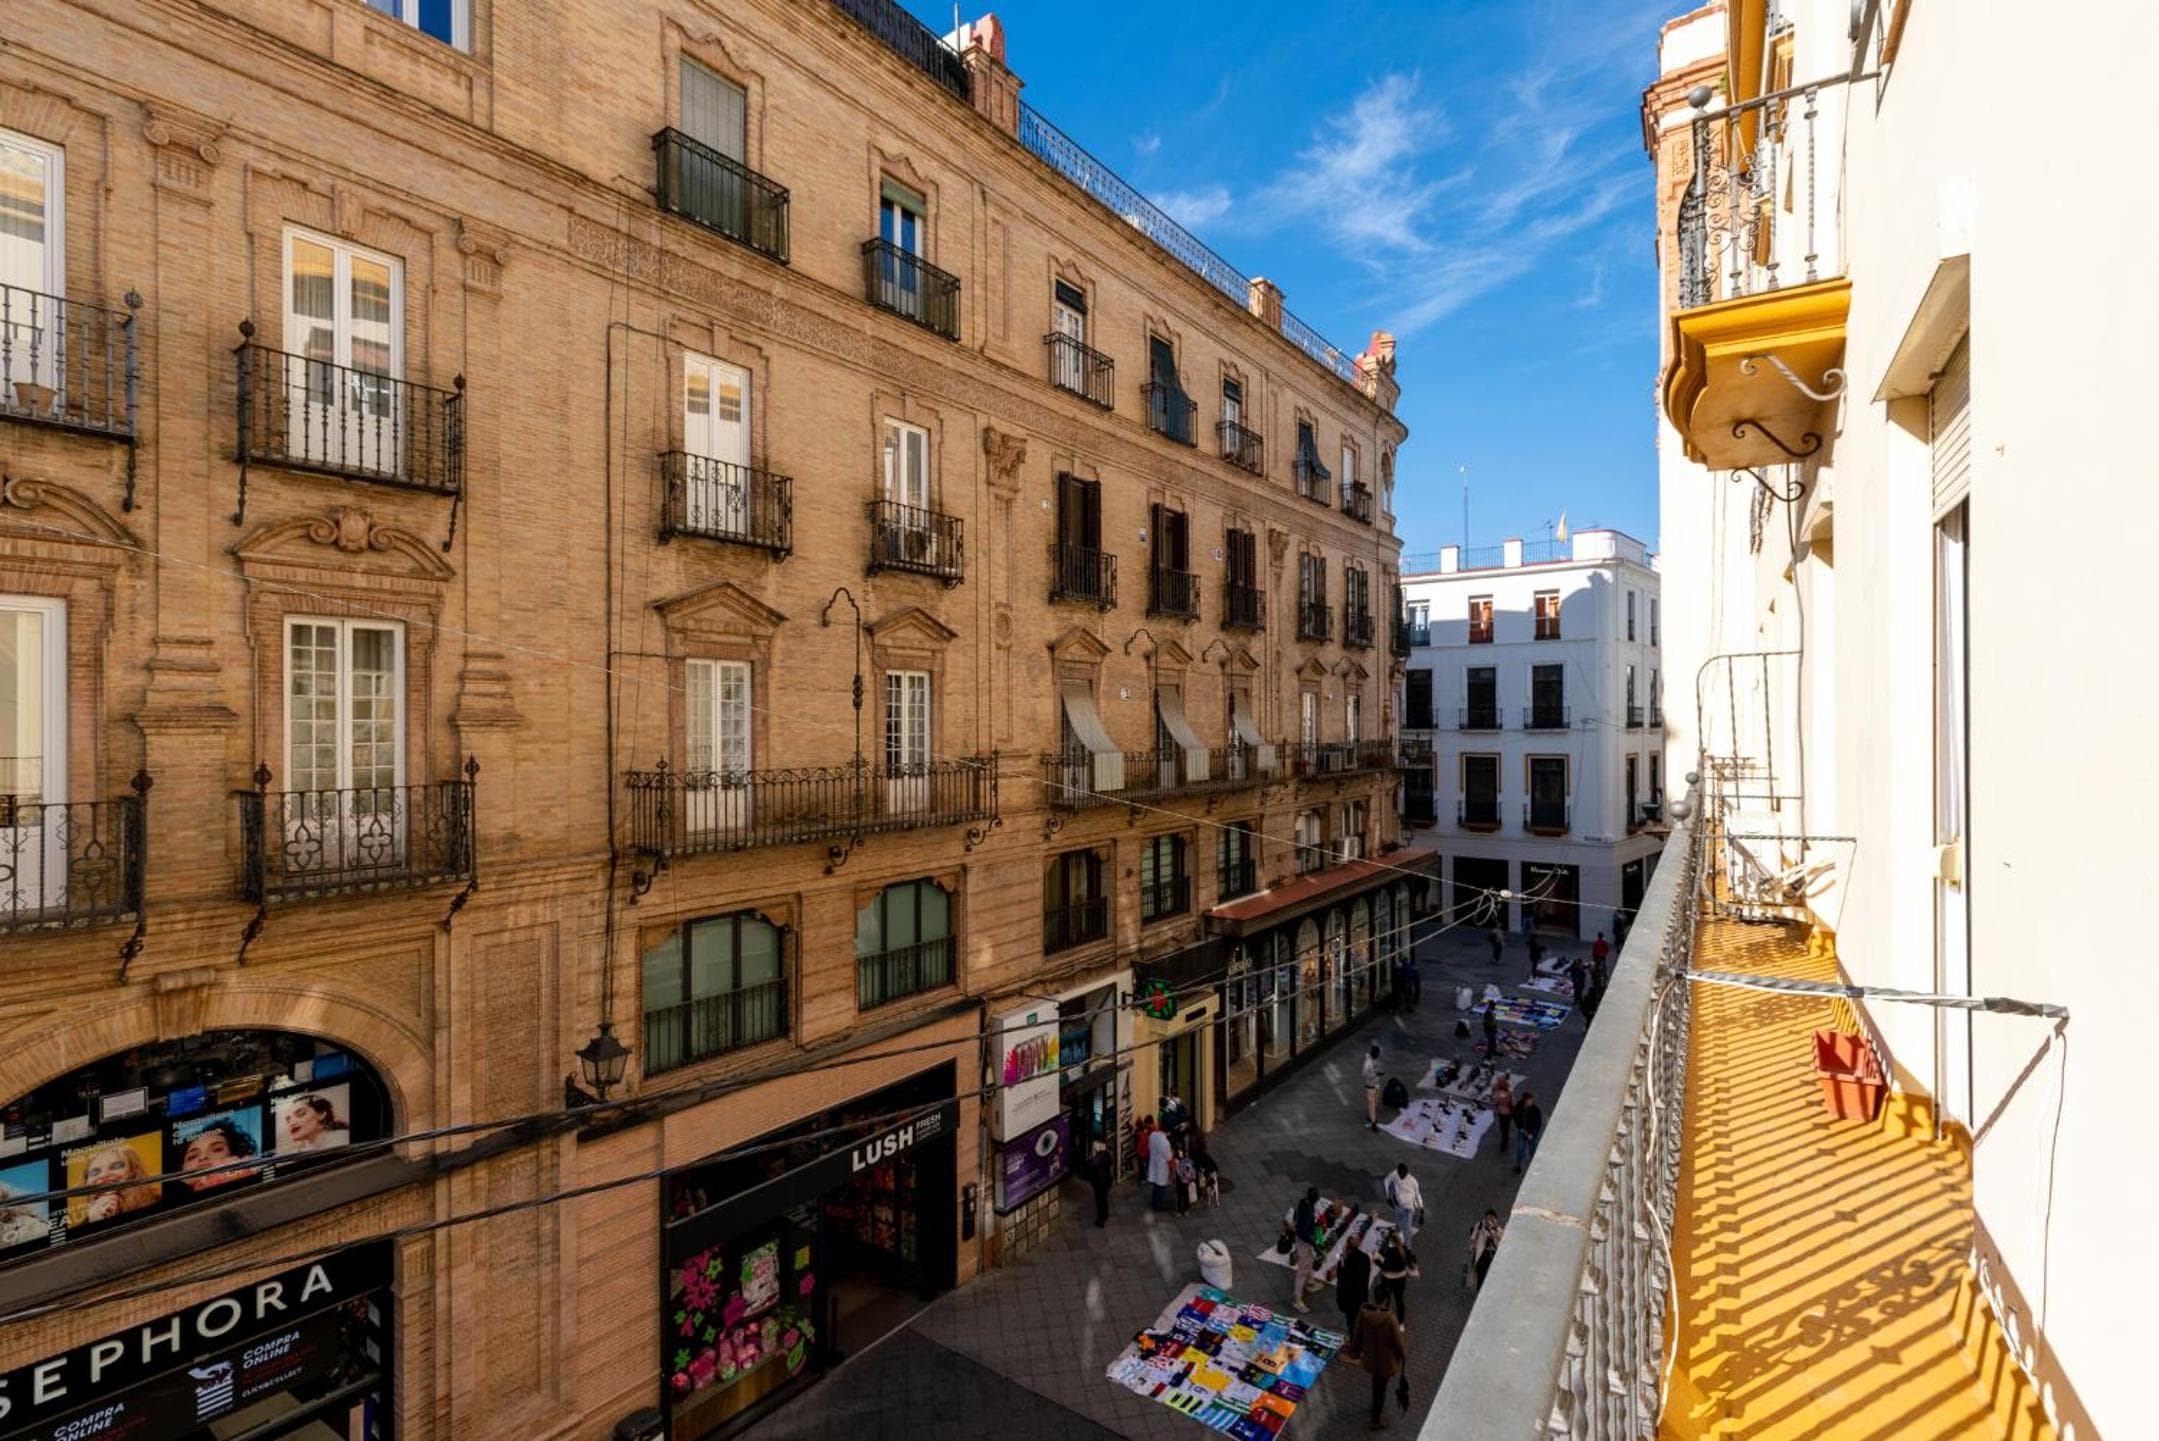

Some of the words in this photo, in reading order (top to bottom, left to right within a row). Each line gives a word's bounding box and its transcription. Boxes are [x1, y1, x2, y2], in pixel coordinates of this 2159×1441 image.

[916, 1111, 942, 1132] FRESH
[852, 1124, 914, 1173] LUSH
[243, 1329, 301, 1361] COMPRA
[243, 1343, 290, 1370] ONLINE
[53, 1401, 125, 1438] COMPRA
[55, 1416, 113, 1441] ONLINE
